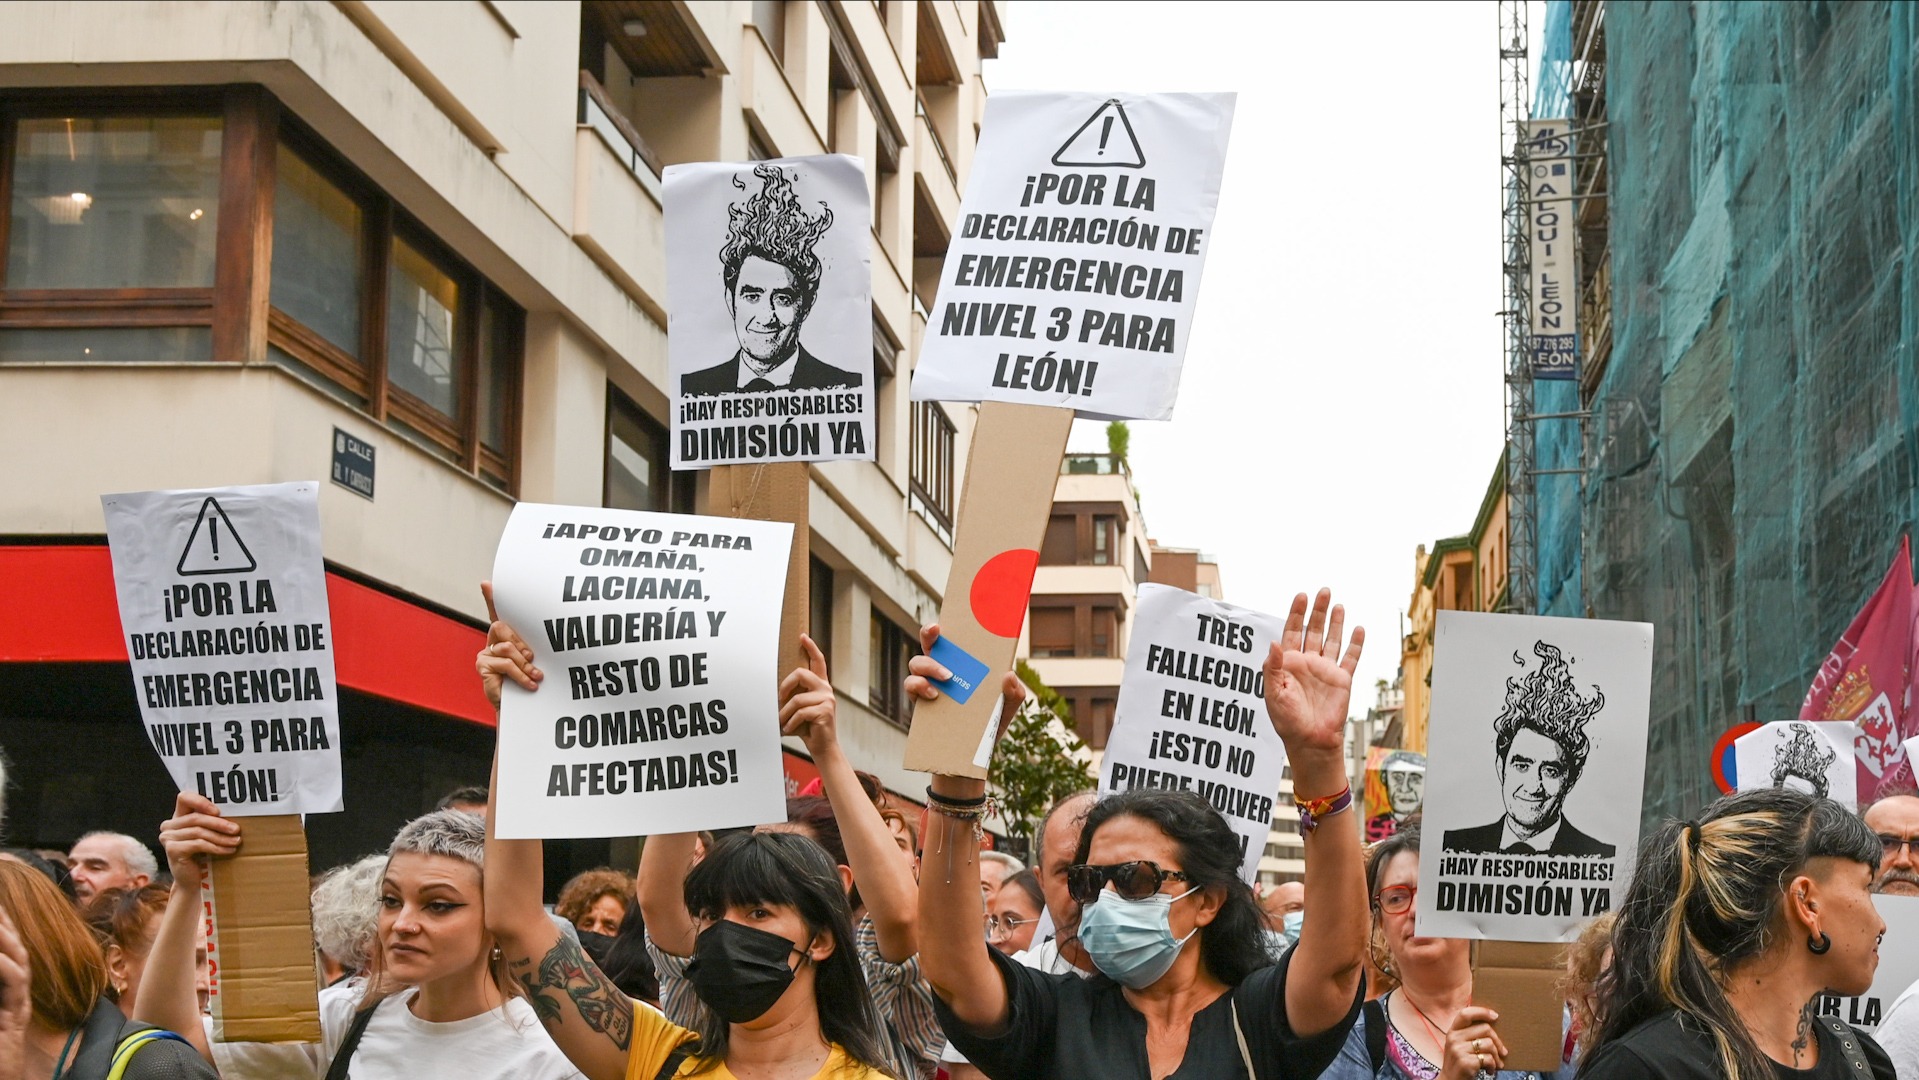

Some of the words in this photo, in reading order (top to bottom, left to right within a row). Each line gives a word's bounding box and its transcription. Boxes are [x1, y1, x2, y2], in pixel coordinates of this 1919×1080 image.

[1020, 173, 1107, 207] ¡POR
[1113, 174, 1156, 212] LA
[961, 213, 1160, 251] DECLARACIÓN
[1164, 227, 1203, 255] DE
[954, 254, 1184, 303] EMERGENCIA
[940, 302, 1037, 340] NIVEL
[1046, 306, 1072, 342] 3
[1078, 309, 1176, 354] PARA
[992, 351, 1099, 397] LEÓN!
[680, 400, 717, 424] ¡HAY
[721, 393, 863, 418] RESPONSABLES!
[348, 439, 372, 461] CALLE
[680, 417, 820, 462] DIMISIÓN
[827, 421, 866, 455] YA
[542, 523, 663, 545] ¡APOYO
[670, 531, 753, 551] PARA
[579, 547, 705, 573] OMAÑA,
[163, 581, 234, 622] ¡POR
[240, 579, 277, 614] LA
[562, 576, 711, 602] LACIANA,
[131, 621, 288, 660] DECLARACIÓN
[294, 623, 326, 651] DE
[543, 606, 697, 653] VALDERÍA
[706, 611, 727, 637] Y
[1197, 613, 1254, 654] TRES
[143, 667, 324, 709] EMERGENCIA
[568, 656, 661, 701] RESTO
[669, 652, 709, 689] DE
[952, 675, 971, 690] SEUR
[1146, 643, 1265, 699] FALLECIDO
[554, 699, 729, 750] COMARCAS
[1160, 688, 1194, 722] EN
[1198, 699, 1257, 738] LEÓN.
[151, 722, 219, 757] NIVEL
[226, 720, 244, 755] 3
[252, 717, 330, 752] PARA
[1148, 730, 1222, 769] ¡ESTO
[1226, 745, 1255, 778] NO
[196, 764, 279, 805] LEÓN!
[546, 749, 739, 797] AFECTADAS!
[1198, 779, 1273, 825] VOLVER
[1439, 857, 1478, 877] ¡HAY
[1481, 859, 1615, 881] RESPONSABLES!
[1436, 881, 1573, 917] DIMISIÓN
[1581, 887, 1611, 917] YA
[1849, 997, 1881, 1027] LA
